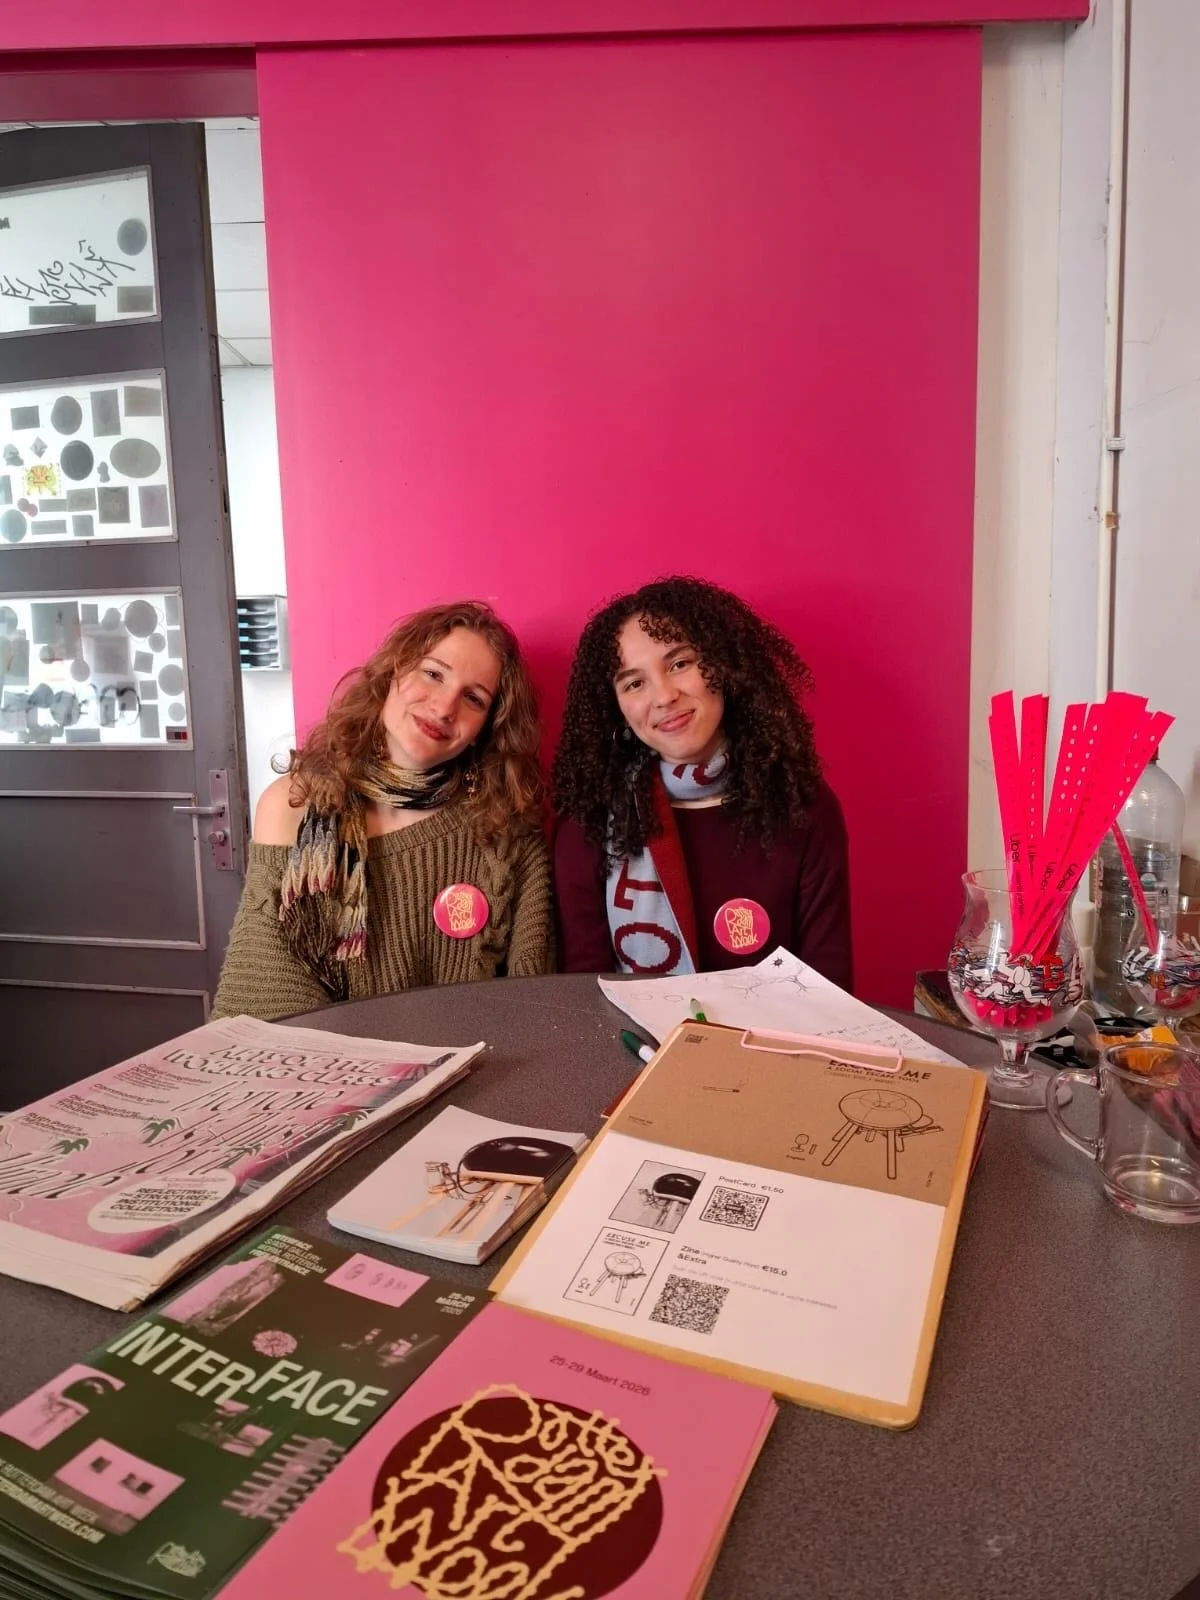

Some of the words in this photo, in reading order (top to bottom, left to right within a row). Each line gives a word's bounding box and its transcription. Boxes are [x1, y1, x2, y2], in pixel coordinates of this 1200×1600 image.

[1009, 833, 1021, 864] Uber
[1056, 863, 1079, 892] Uber
[903, 1070, 932, 1080] ME
[718, 1176, 757, 1188] PostCard
[677, 1252, 708, 1265] &Extra
[680, 1245, 701, 1255] Zine
[281, 1251, 328, 1274] ROTTERDAM
[435, 1297, 471, 1309] MARCH
[106, 1321, 389, 1426] INTERFACE
[549, 1354, 585, 1373] 25-29
[585, 1367, 619, 1386] Maart
[619, 1379, 651, 1397] 2026
[69, 1504, 99, 1524] WEEK
